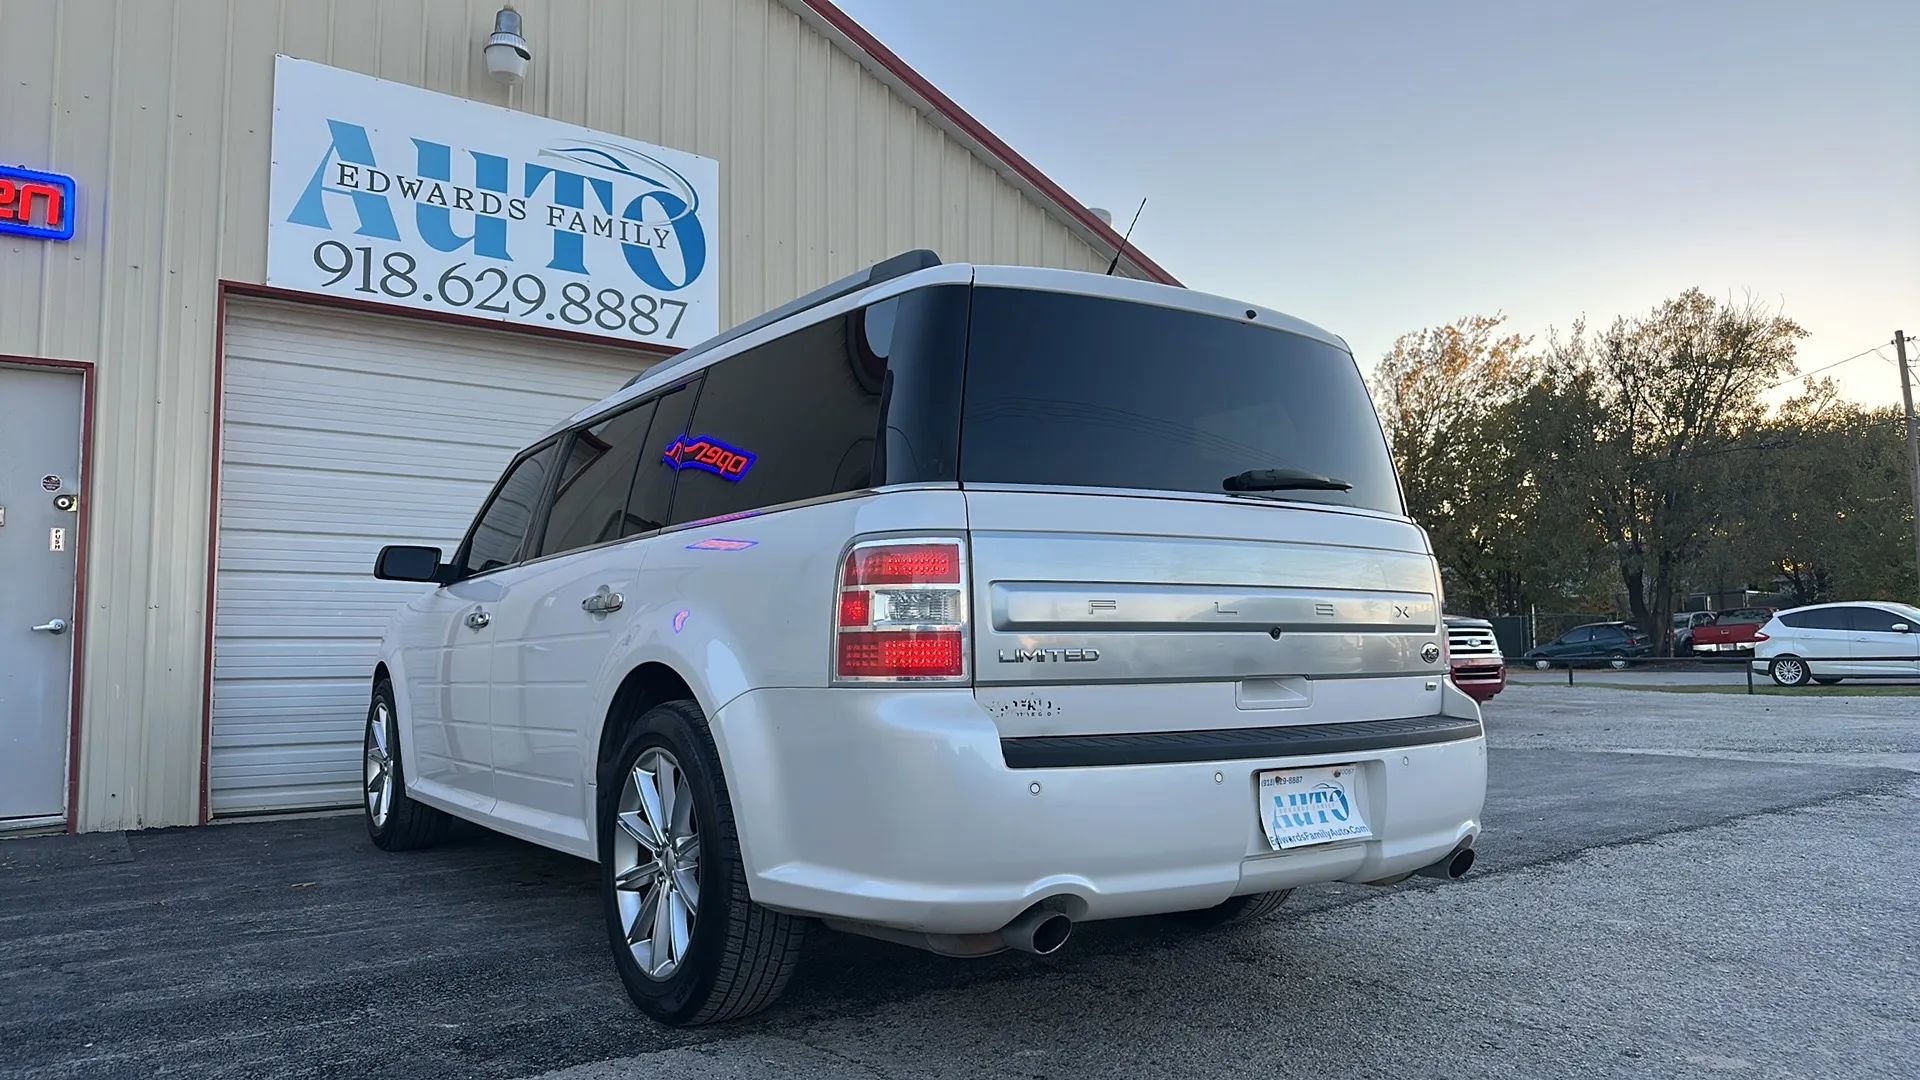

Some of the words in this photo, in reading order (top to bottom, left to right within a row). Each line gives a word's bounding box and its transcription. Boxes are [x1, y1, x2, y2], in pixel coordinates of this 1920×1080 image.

[336, 162, 527, 221] EDWARDS
[546, 205, 670, 249] FAMILY
[313, 240, 689, 340] 918.629.8887
[1088, 600, 1409, 618] FLEX
[998, 648, 1100, 663] LIMITED
